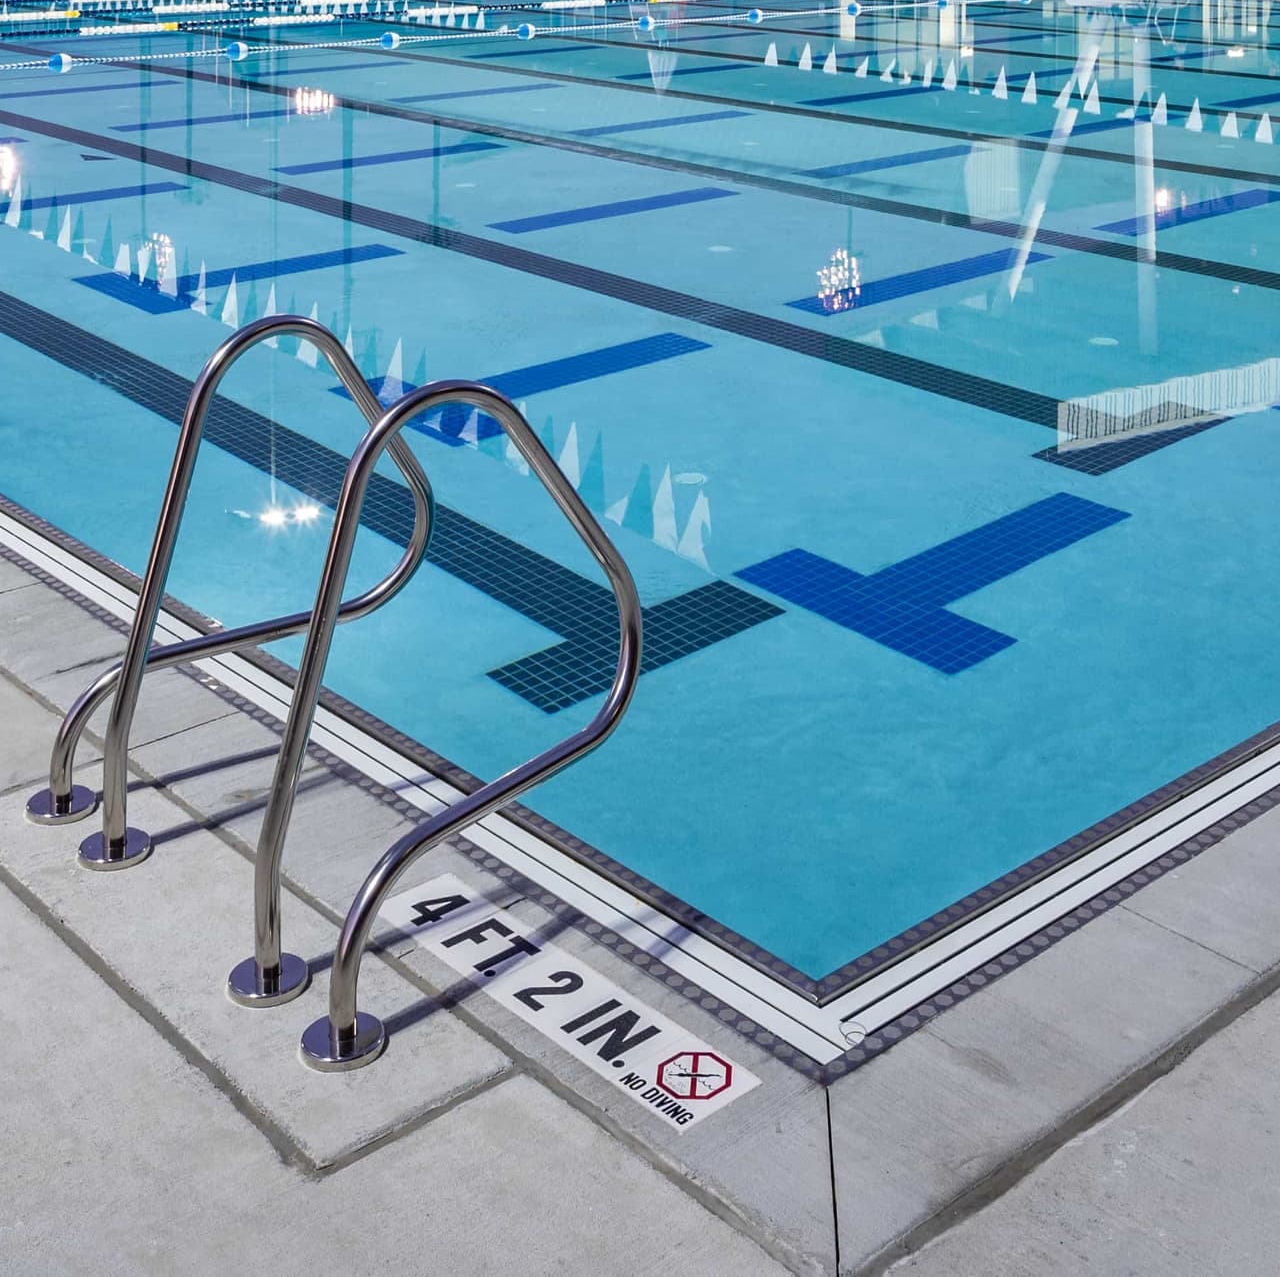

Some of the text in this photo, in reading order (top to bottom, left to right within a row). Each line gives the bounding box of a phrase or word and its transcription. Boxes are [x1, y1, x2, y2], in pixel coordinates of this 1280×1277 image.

[410, 894, 662, 1069] 4 FT. 2 IN.
[619, 1072, 695, 1126] NO DIVING
